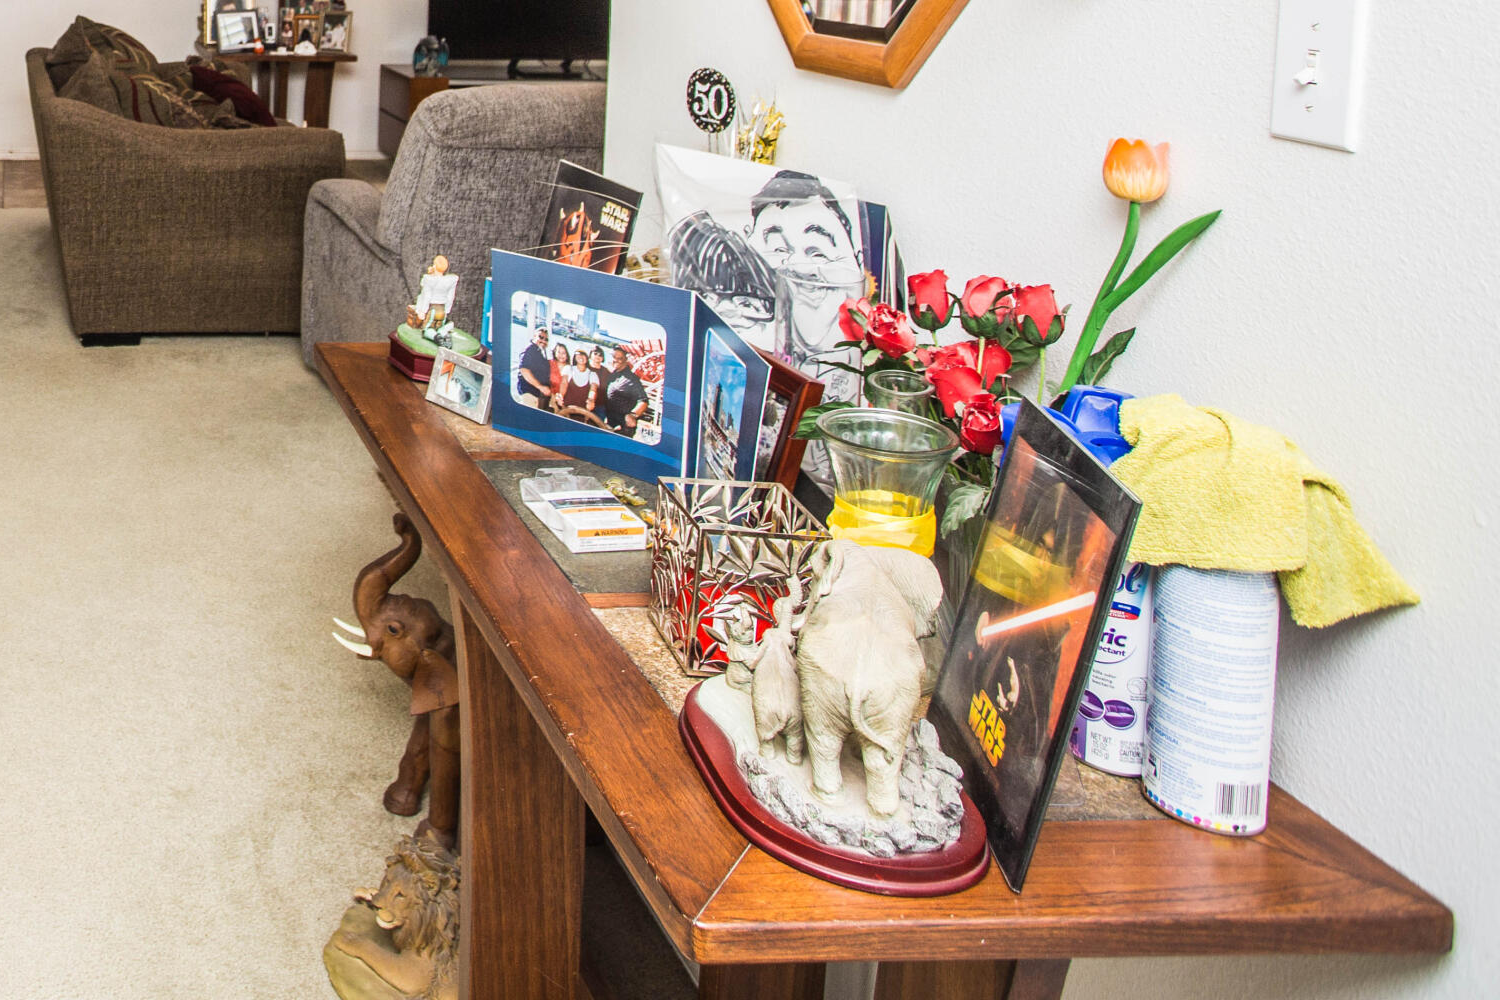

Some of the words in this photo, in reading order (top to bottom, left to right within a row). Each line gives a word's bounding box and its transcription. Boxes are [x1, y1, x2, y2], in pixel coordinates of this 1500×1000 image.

[693, 81, 728, 119] 50
[600, 211, 629, 234] WARS
[602, 201, 630, 222] STAR
[968, 700, 1004, 767] WARS
[972, 689, 1007, 752] STAR
